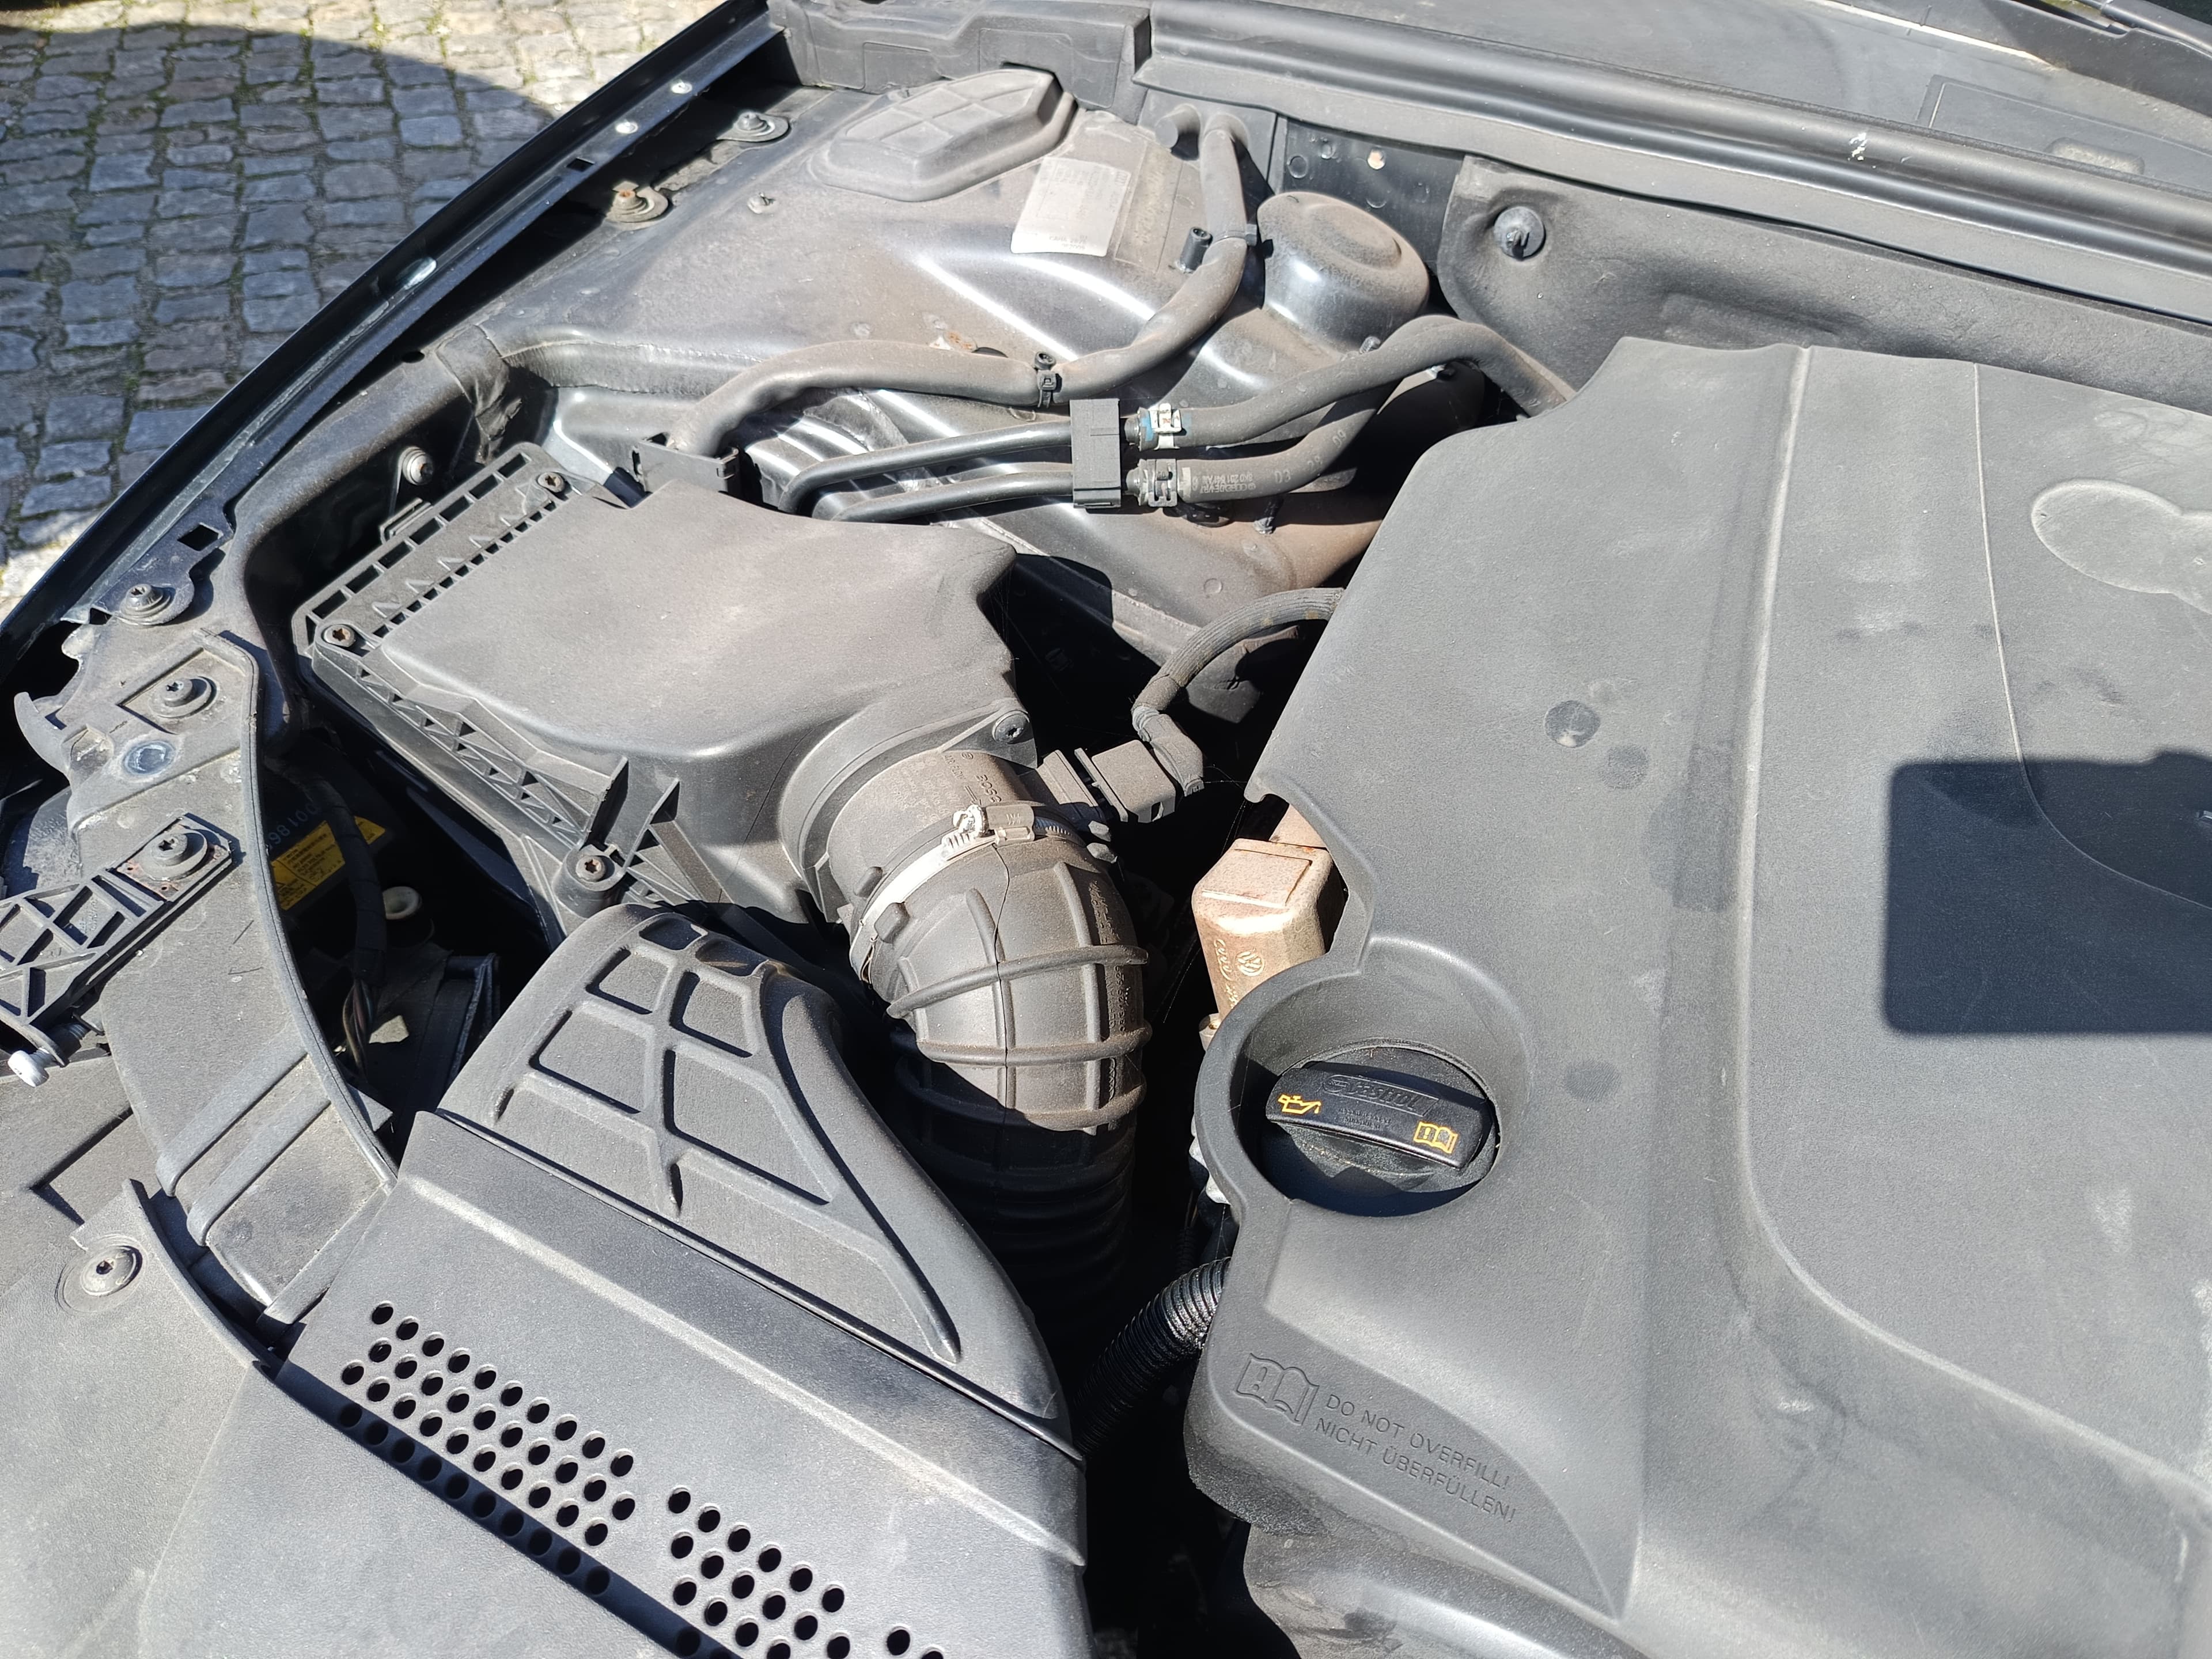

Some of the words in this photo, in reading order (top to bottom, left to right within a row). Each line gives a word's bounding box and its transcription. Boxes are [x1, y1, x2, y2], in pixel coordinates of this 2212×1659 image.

[976, 774, 1002, 802] BOSC
[1315, 1417, 1377, 1456] NICHT
[1382, 1446, 1517, 1523] ÜBERFÜLLEN!
[1325, 1394, 1355, 1416] DO
[1361, 1409, 1404, 1440] NOT
[1410, 1432, 1512, 1490] OVERFILL!
